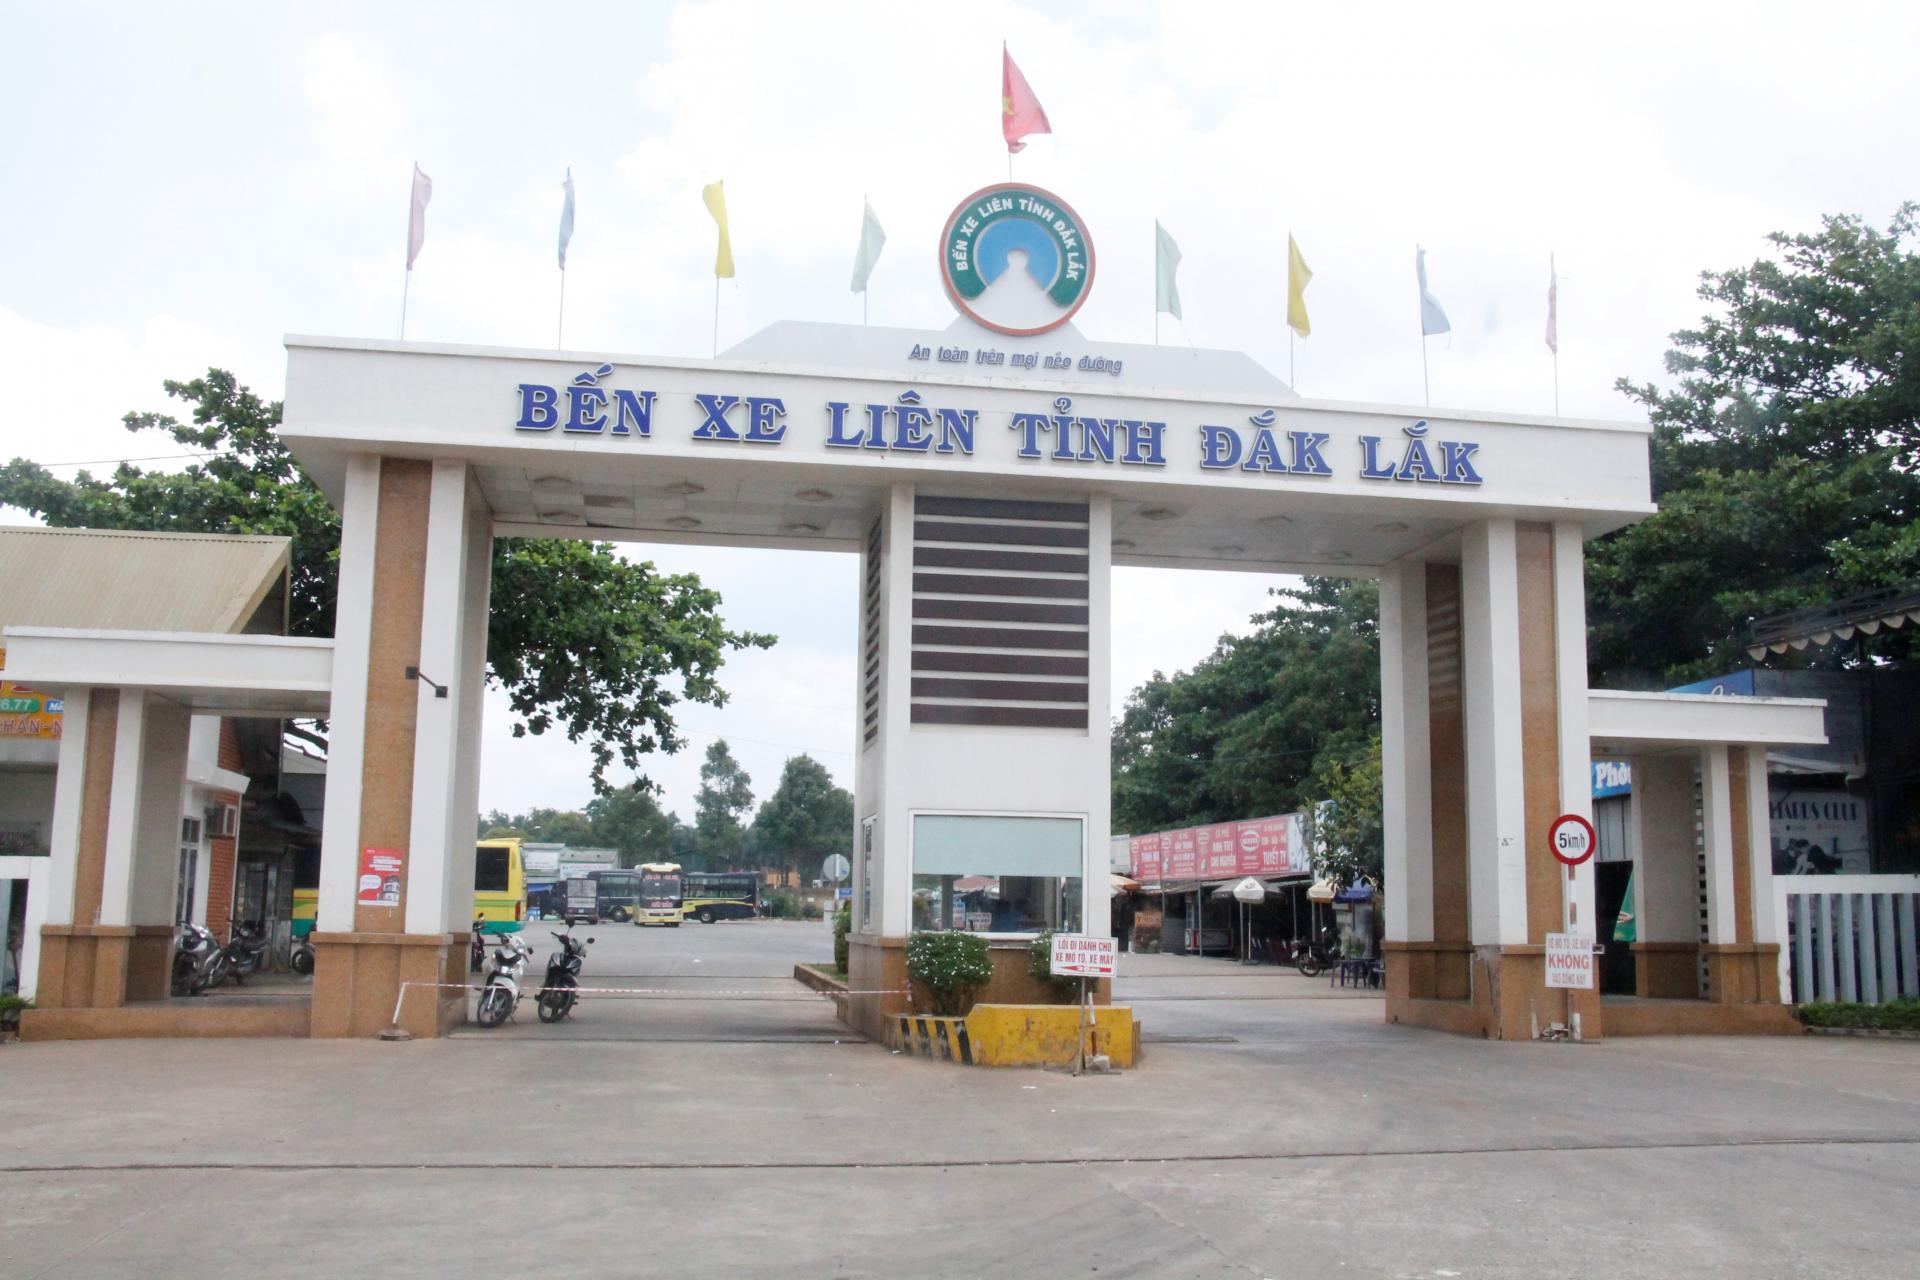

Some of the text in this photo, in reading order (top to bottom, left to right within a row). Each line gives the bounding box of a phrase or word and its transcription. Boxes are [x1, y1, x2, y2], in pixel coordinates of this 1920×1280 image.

[952, 239, 968, 272] BẾN
[960, 216, 979, 237] XE
[978, 197, 1013, 218] LIÊN
[1019, 197, 1055, 222] TỈNH
[908, 344, 930, 360] An
[938, 346, 969, 363] toàn
[975, 348, 1005, 365] trên
[1011, 351, 1039, 369] mọi
[515, 362, 1484, 485] BẾN XE LIÊN TỈNH ĐẮK LẮK
[1559, 833, 1585, 849] 5 km/h
[1099, 942, 1111, 952] CHO
[1055, 952, 1063, 962] XE
[1089, 954, 1097, 964] XE
